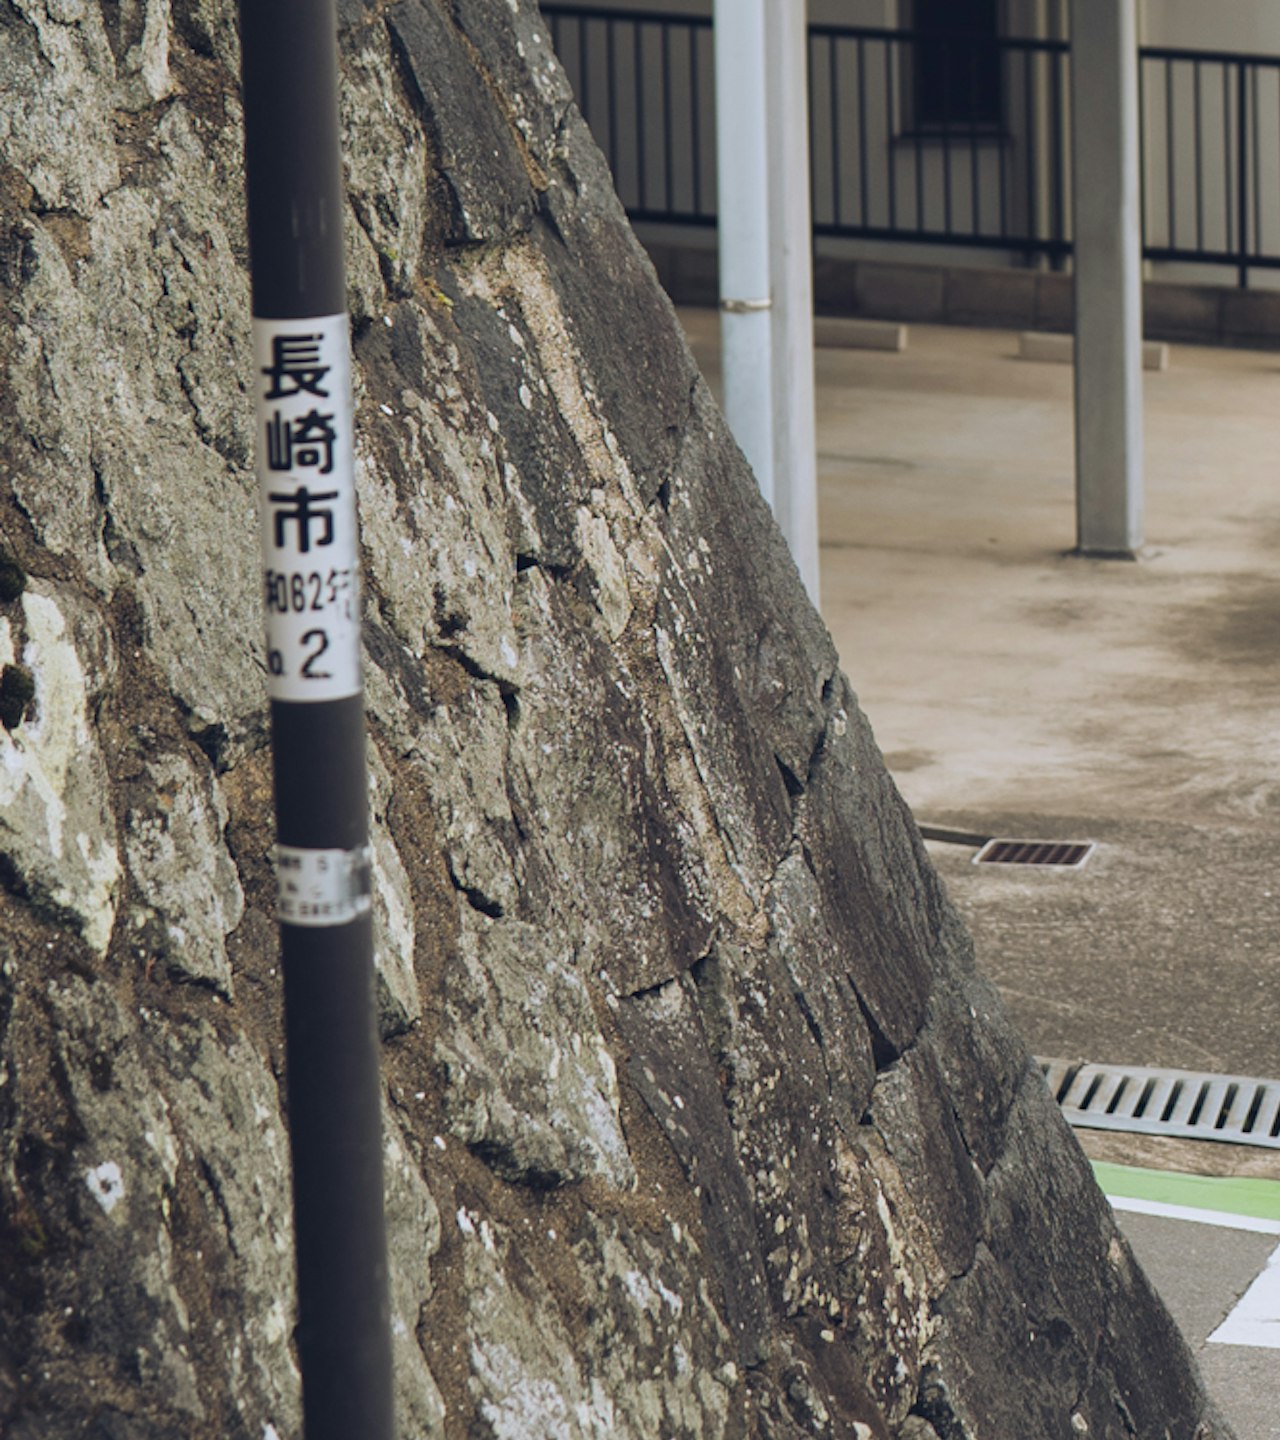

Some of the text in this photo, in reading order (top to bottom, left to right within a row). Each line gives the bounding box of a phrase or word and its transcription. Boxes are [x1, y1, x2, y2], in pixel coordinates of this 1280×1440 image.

[260, 332, 339, 554] 長崎市
[300, 628, 332, 679] 2
